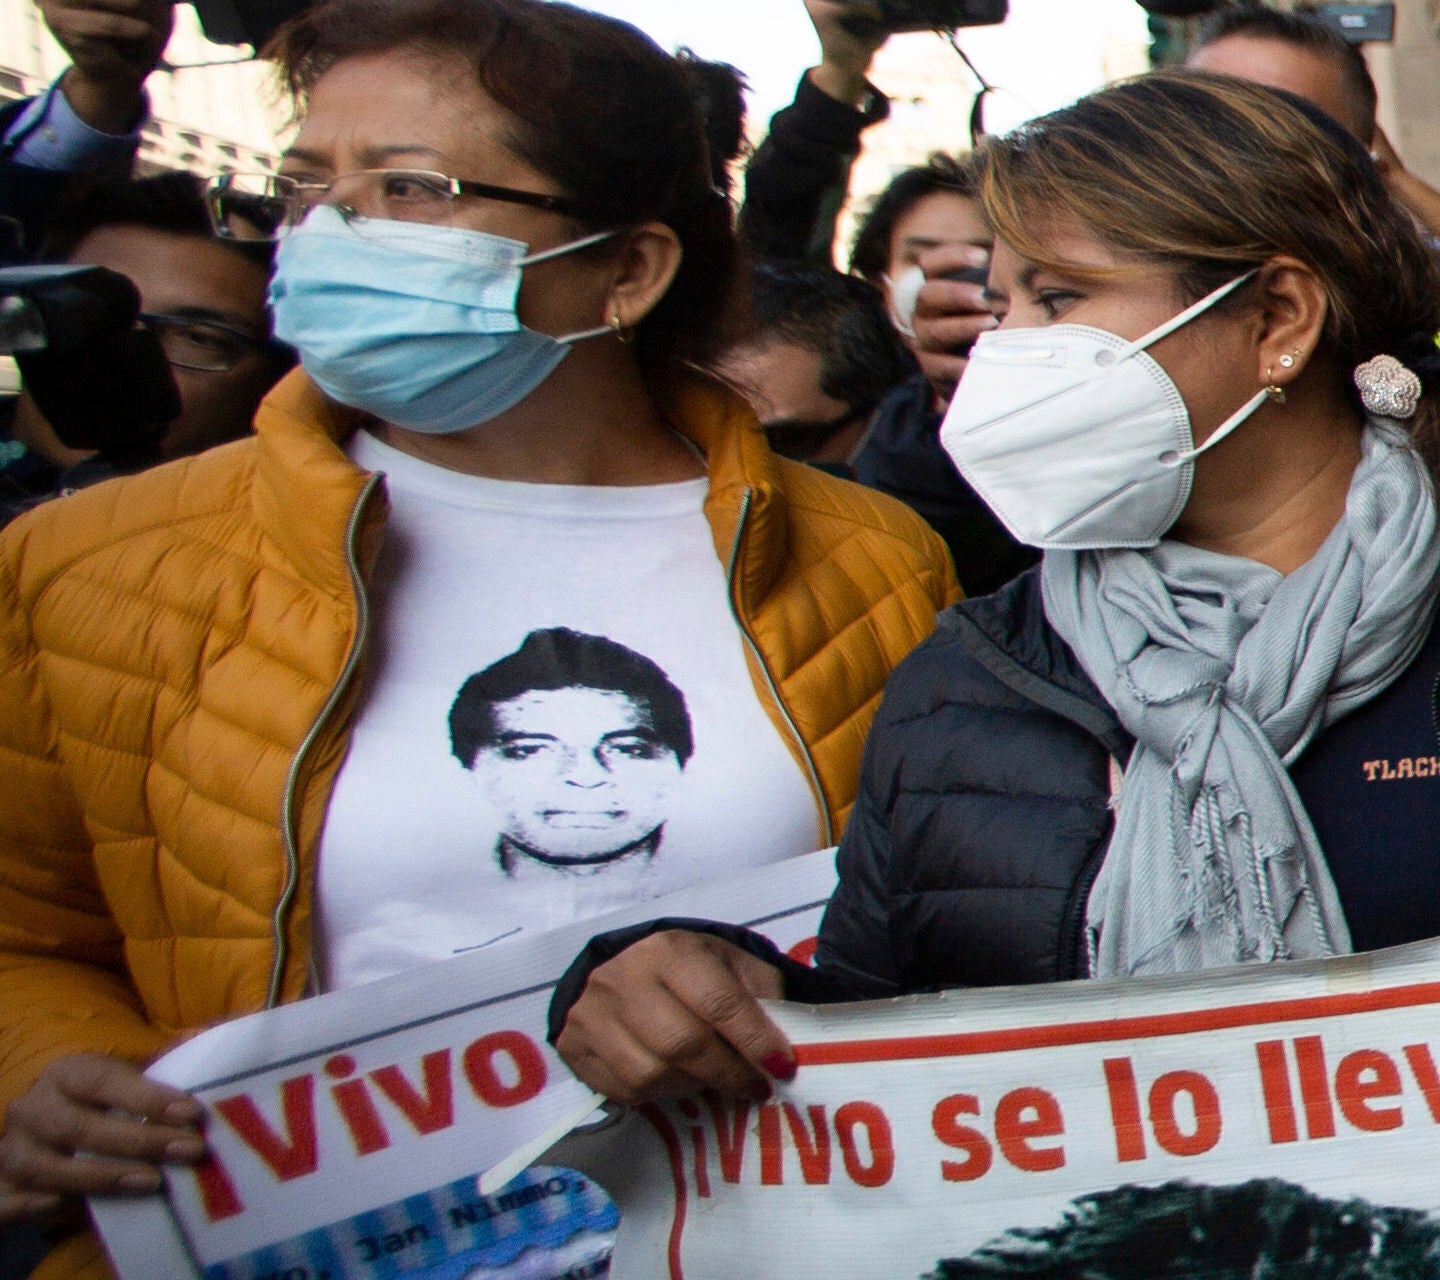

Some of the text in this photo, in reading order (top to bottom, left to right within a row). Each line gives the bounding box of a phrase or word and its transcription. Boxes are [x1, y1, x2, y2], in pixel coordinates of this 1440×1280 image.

[930, 1085, 1067, 1183] se
[1102, 1055, 1223, 1163] lo
[353, 1222, 432, 1263] Jan
